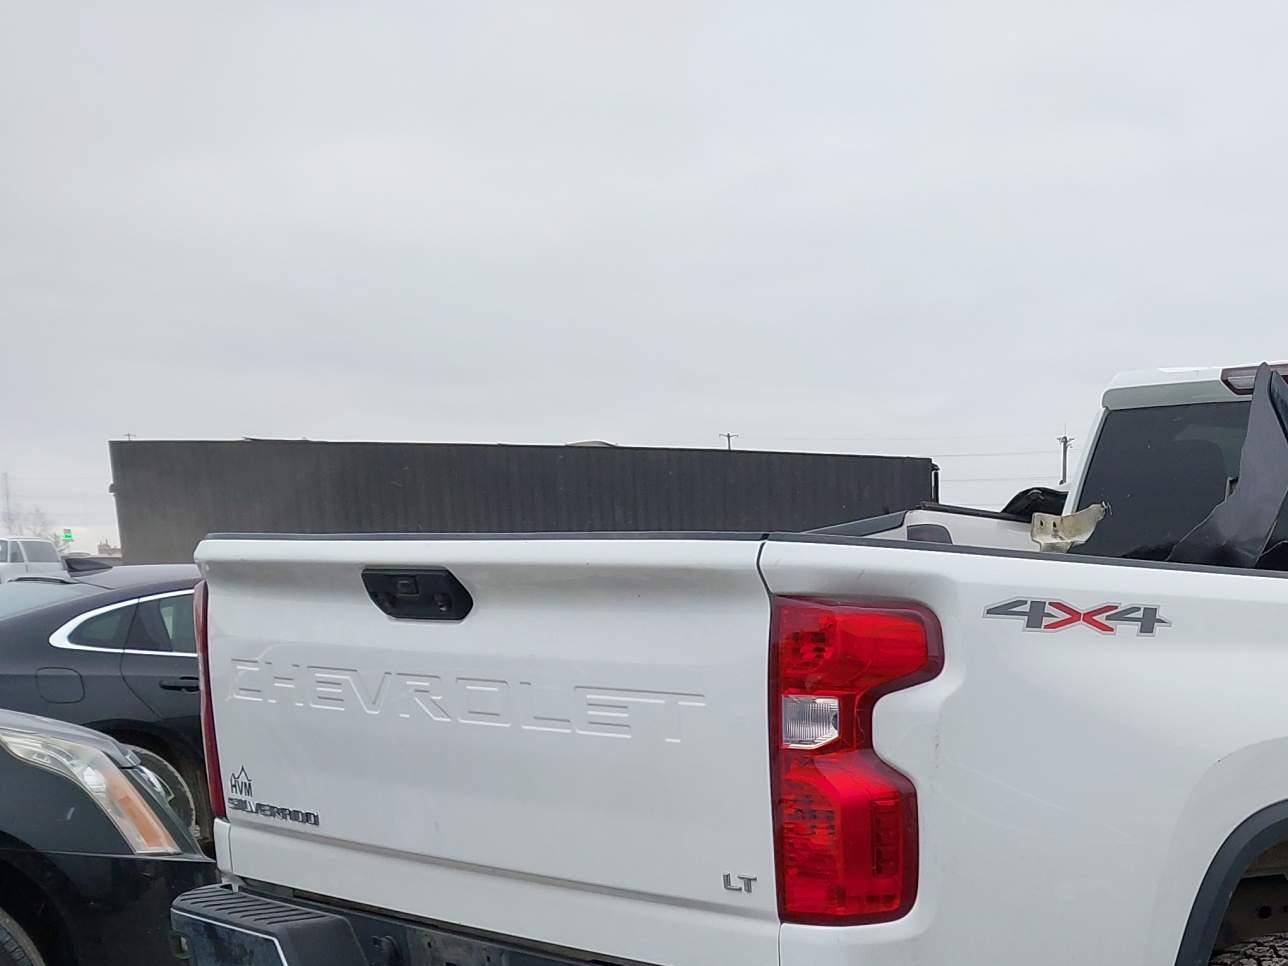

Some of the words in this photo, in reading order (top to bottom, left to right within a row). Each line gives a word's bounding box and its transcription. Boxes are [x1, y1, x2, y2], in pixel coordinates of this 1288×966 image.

[229, 657, 707, 744] CHEVROLET
[230, 780, 253, 798] HVM
[228, 797, 320, 826] SILVERADO
[722, 873, 757, 893] LT
